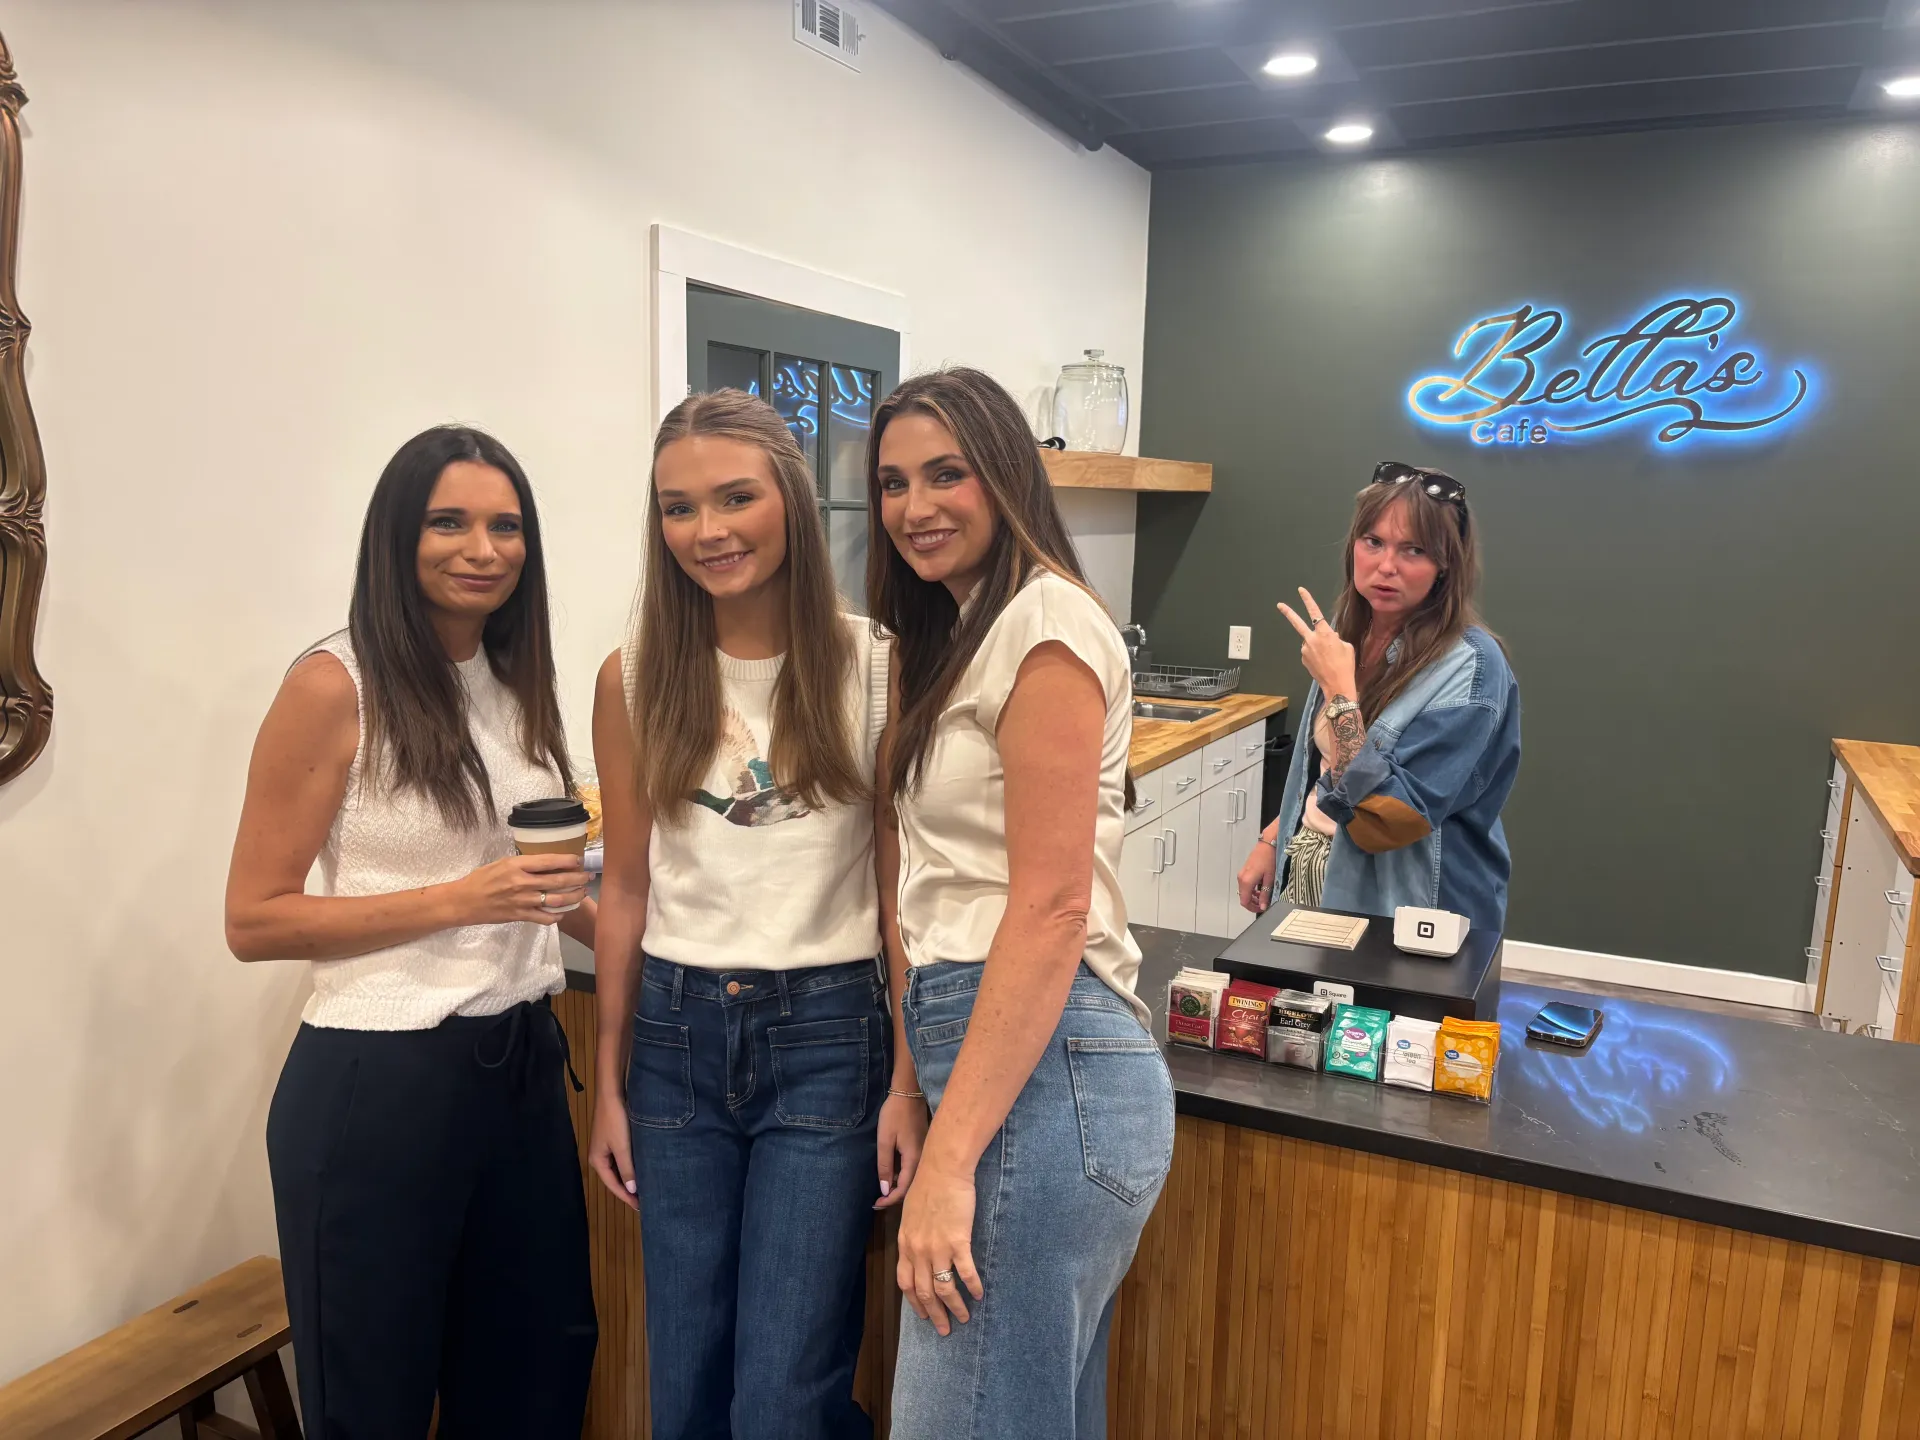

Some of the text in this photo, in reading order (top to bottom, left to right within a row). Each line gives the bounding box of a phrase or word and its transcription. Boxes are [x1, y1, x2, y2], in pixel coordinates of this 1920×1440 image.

[1408, 297, 1764, 423] Betta's
[1328, 990, 1347, 999] Square
[1232, 997, 1264, 1009] TWININGS
[1280, 1017, 1311, 1029] Earl Grey
